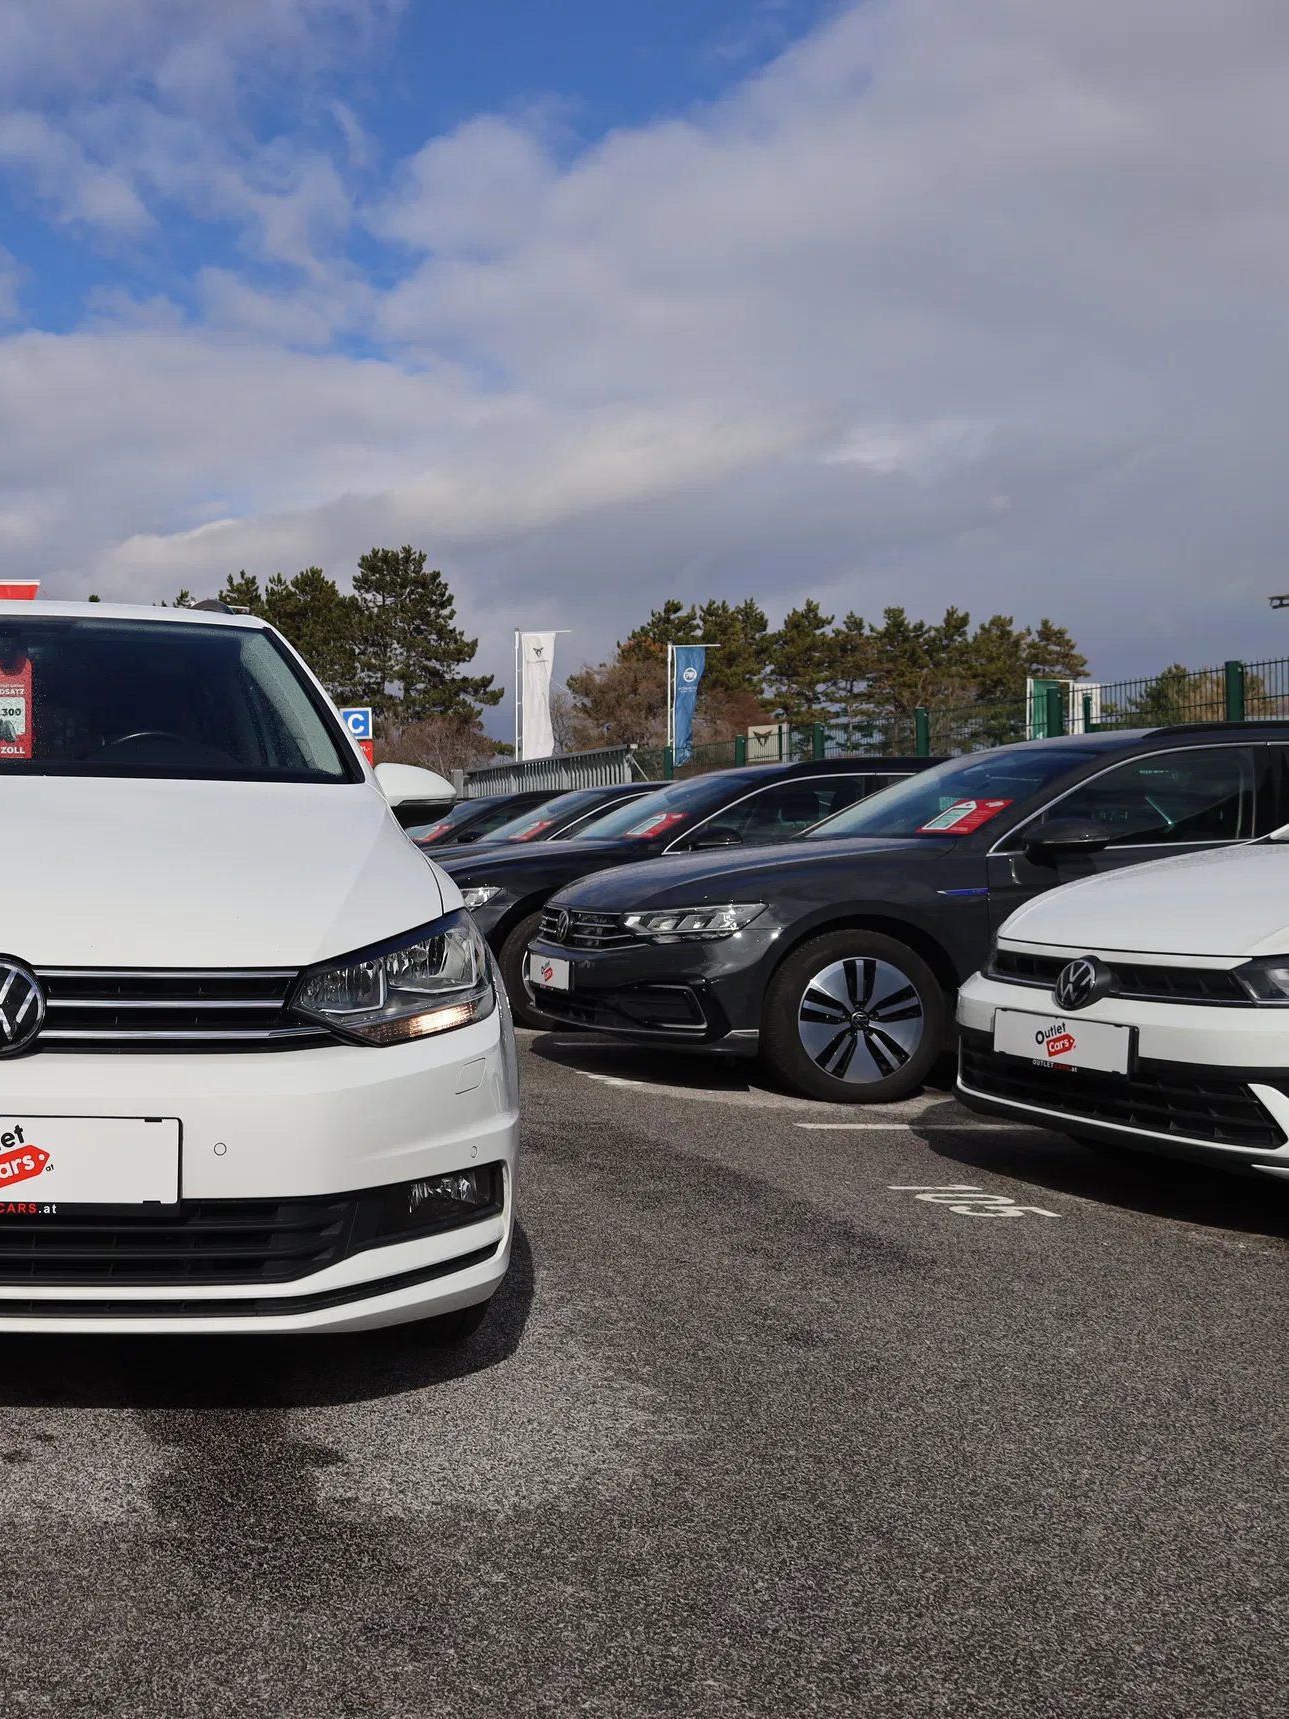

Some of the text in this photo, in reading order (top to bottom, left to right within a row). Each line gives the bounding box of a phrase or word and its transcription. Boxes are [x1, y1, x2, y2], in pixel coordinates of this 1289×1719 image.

[2, 708, 22, 717] 300
[348, 714, 365, 734] C
[0, 746, 26, 755] ZOLL
[1035, 1022, 1066, 1045] Outlet
[1048, 1038, 1069, 1052] Cars
